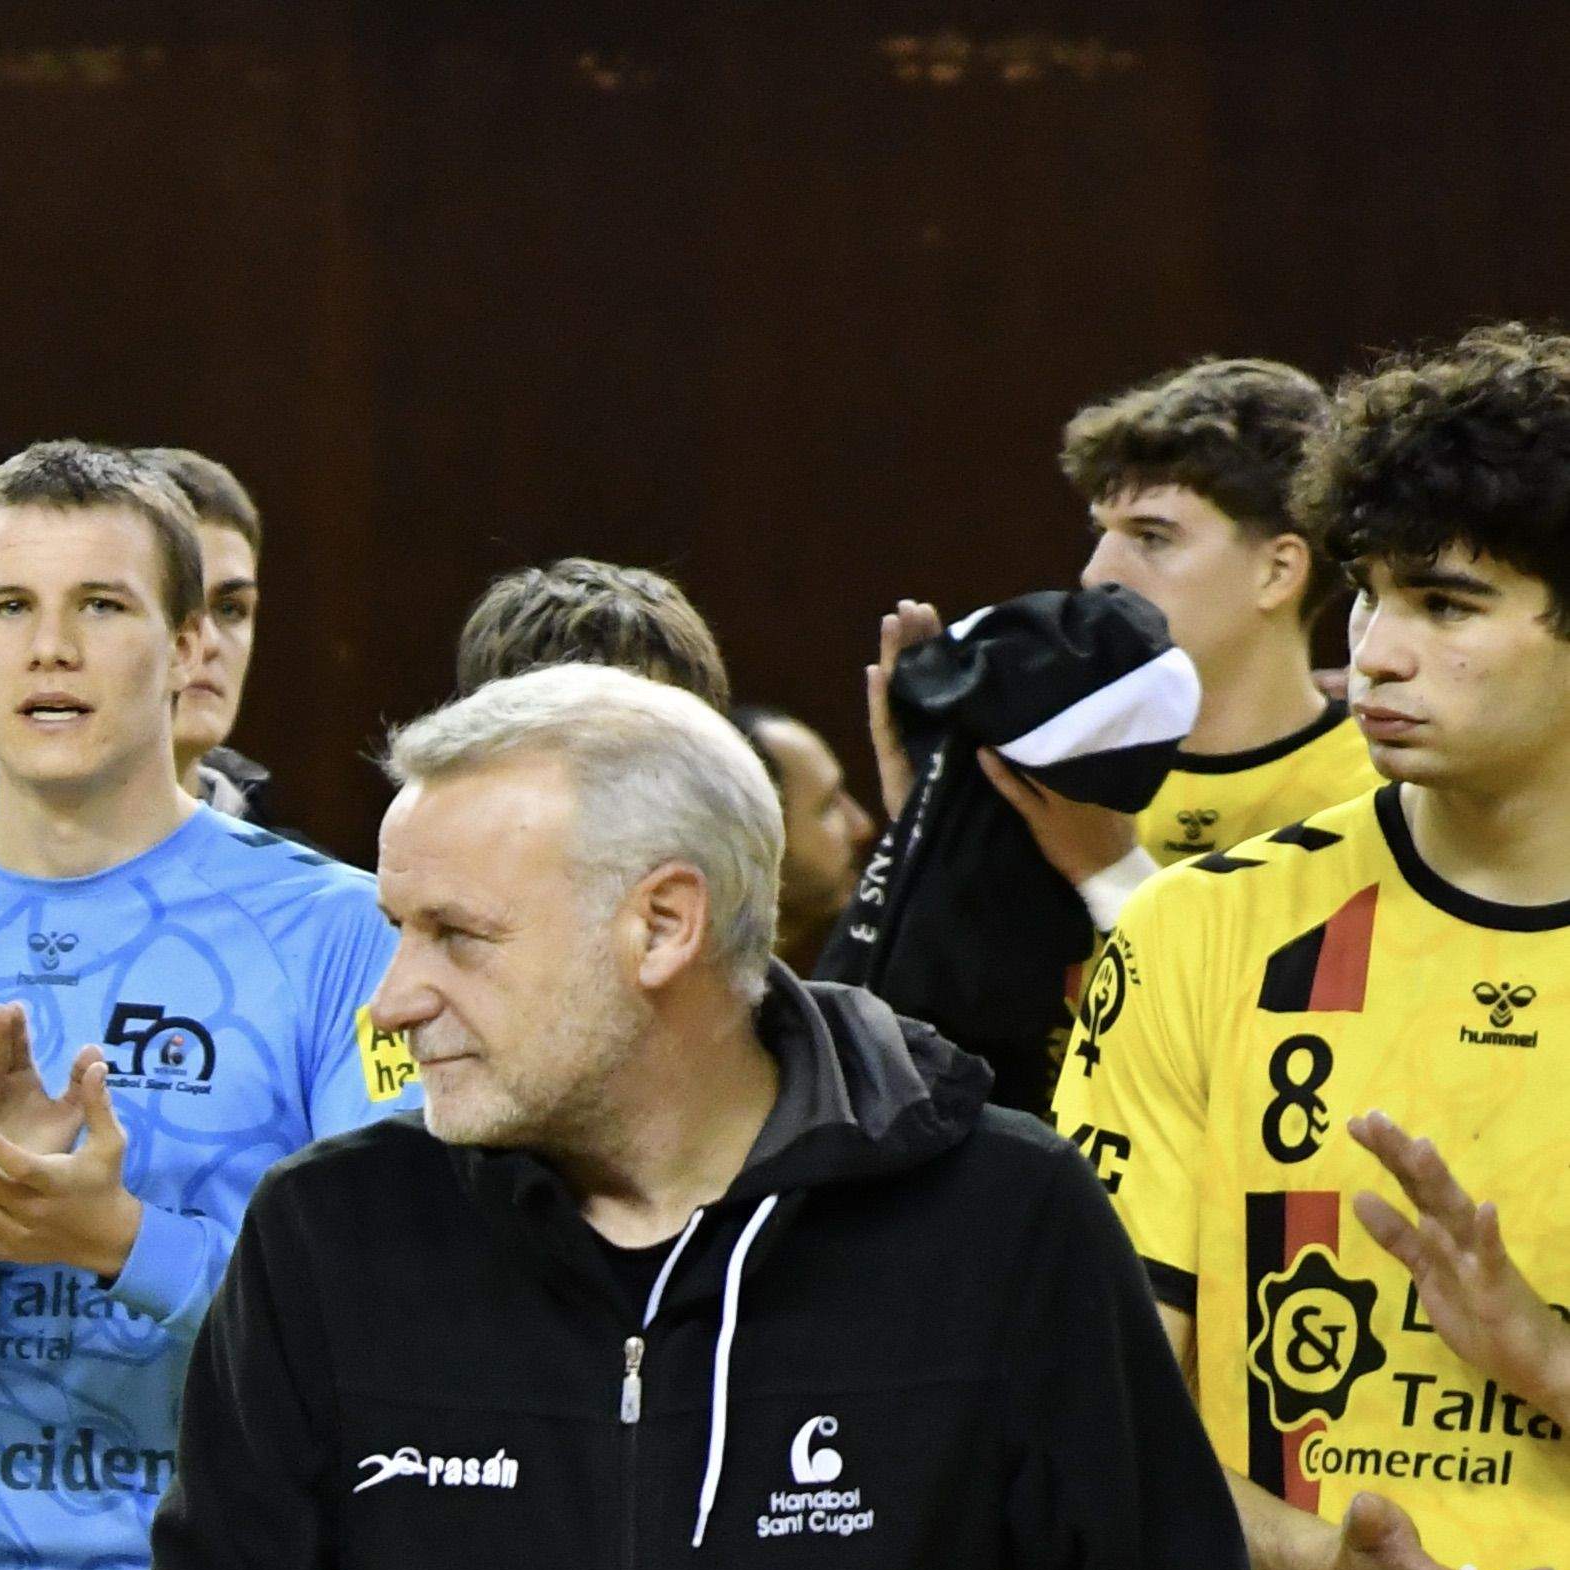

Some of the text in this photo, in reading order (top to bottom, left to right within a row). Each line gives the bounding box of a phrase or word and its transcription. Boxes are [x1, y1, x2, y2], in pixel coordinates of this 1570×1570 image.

[1460, 1025, 1539, 1048] hummel
[1262, 1033, 1334, 1164] 8
[1306, 1437, 1513, 1485] Comercial
[770, 1487, 860, 1513] Handbol
[757, 1509, 875, 1538] Sant Cugat
